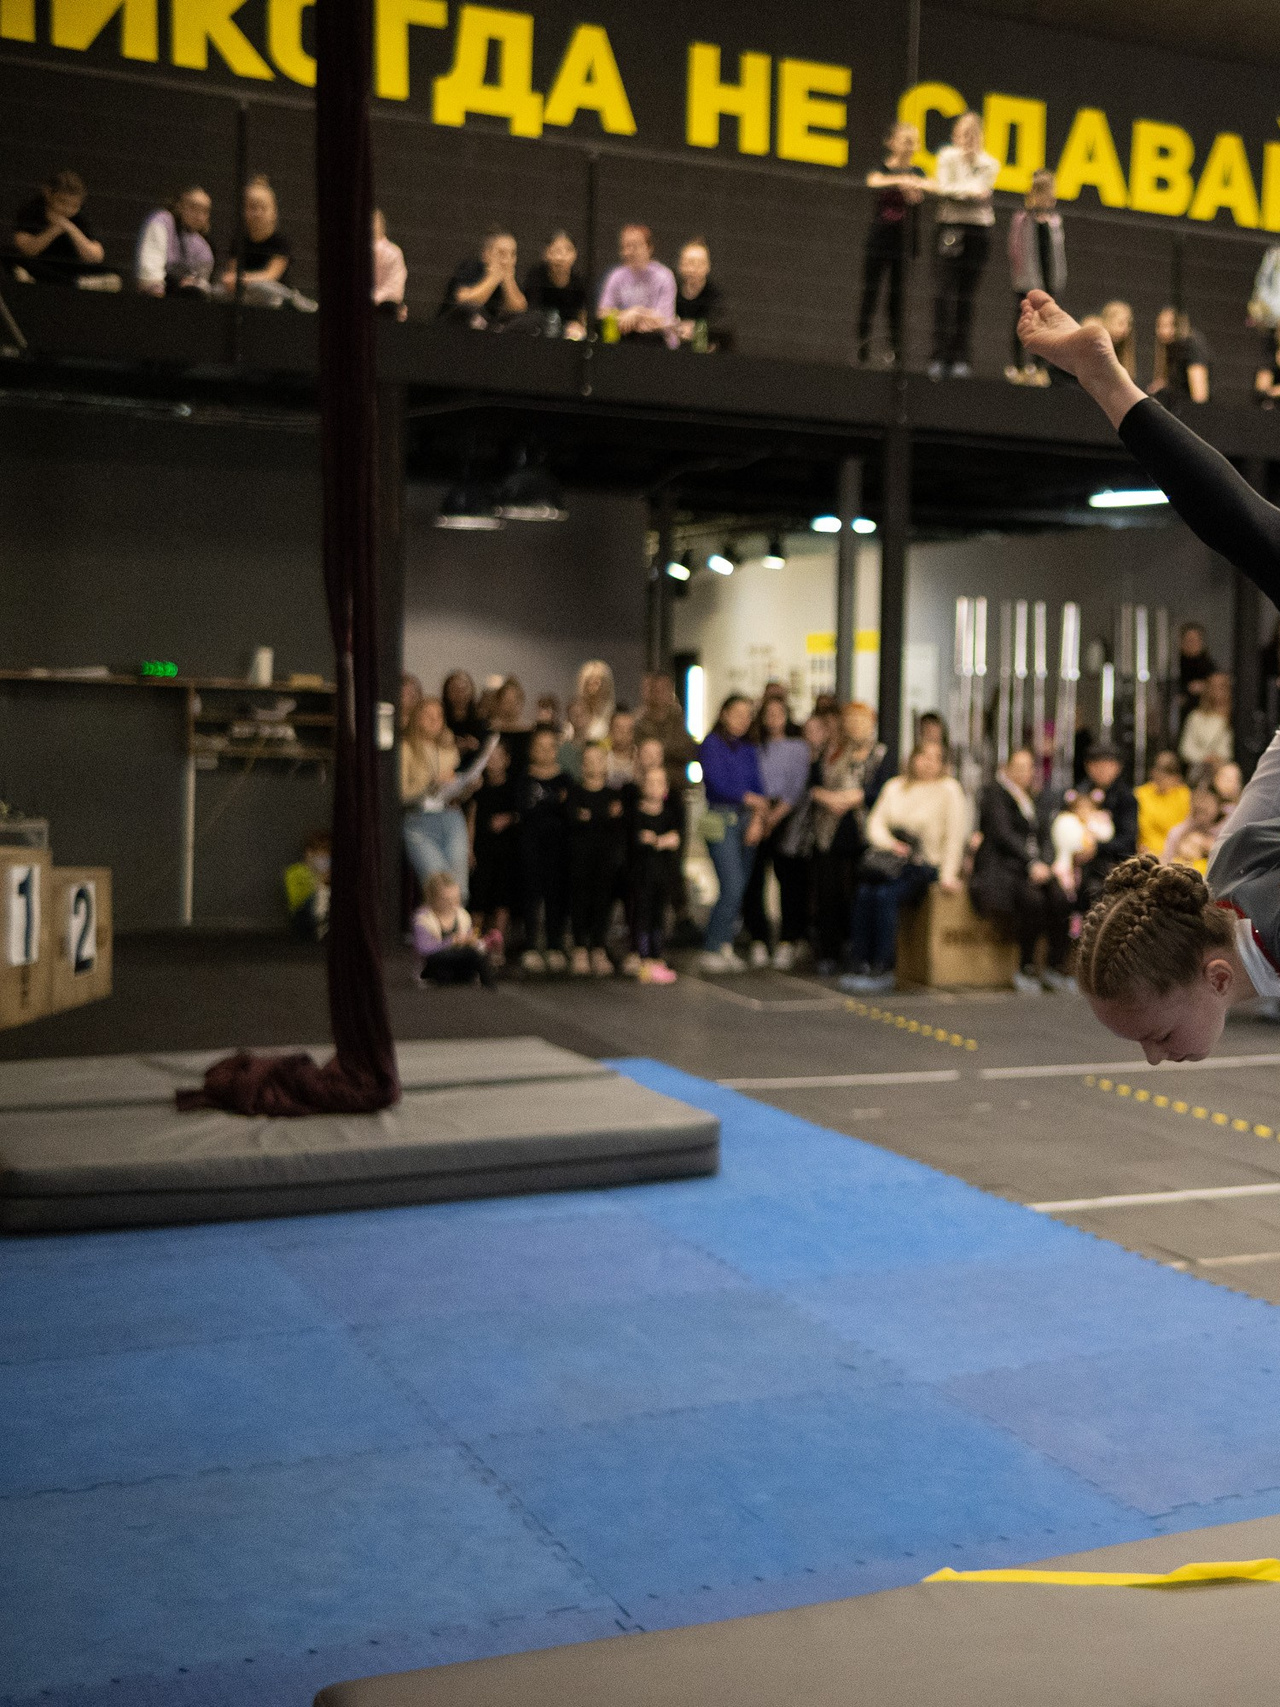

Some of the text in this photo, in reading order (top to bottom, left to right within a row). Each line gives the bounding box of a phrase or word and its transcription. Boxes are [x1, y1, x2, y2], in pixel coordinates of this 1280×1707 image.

[686, 42, 852, 167] НЕ
[18, 866, 33, 962] 1
[73, 886, 94, 976] 2
